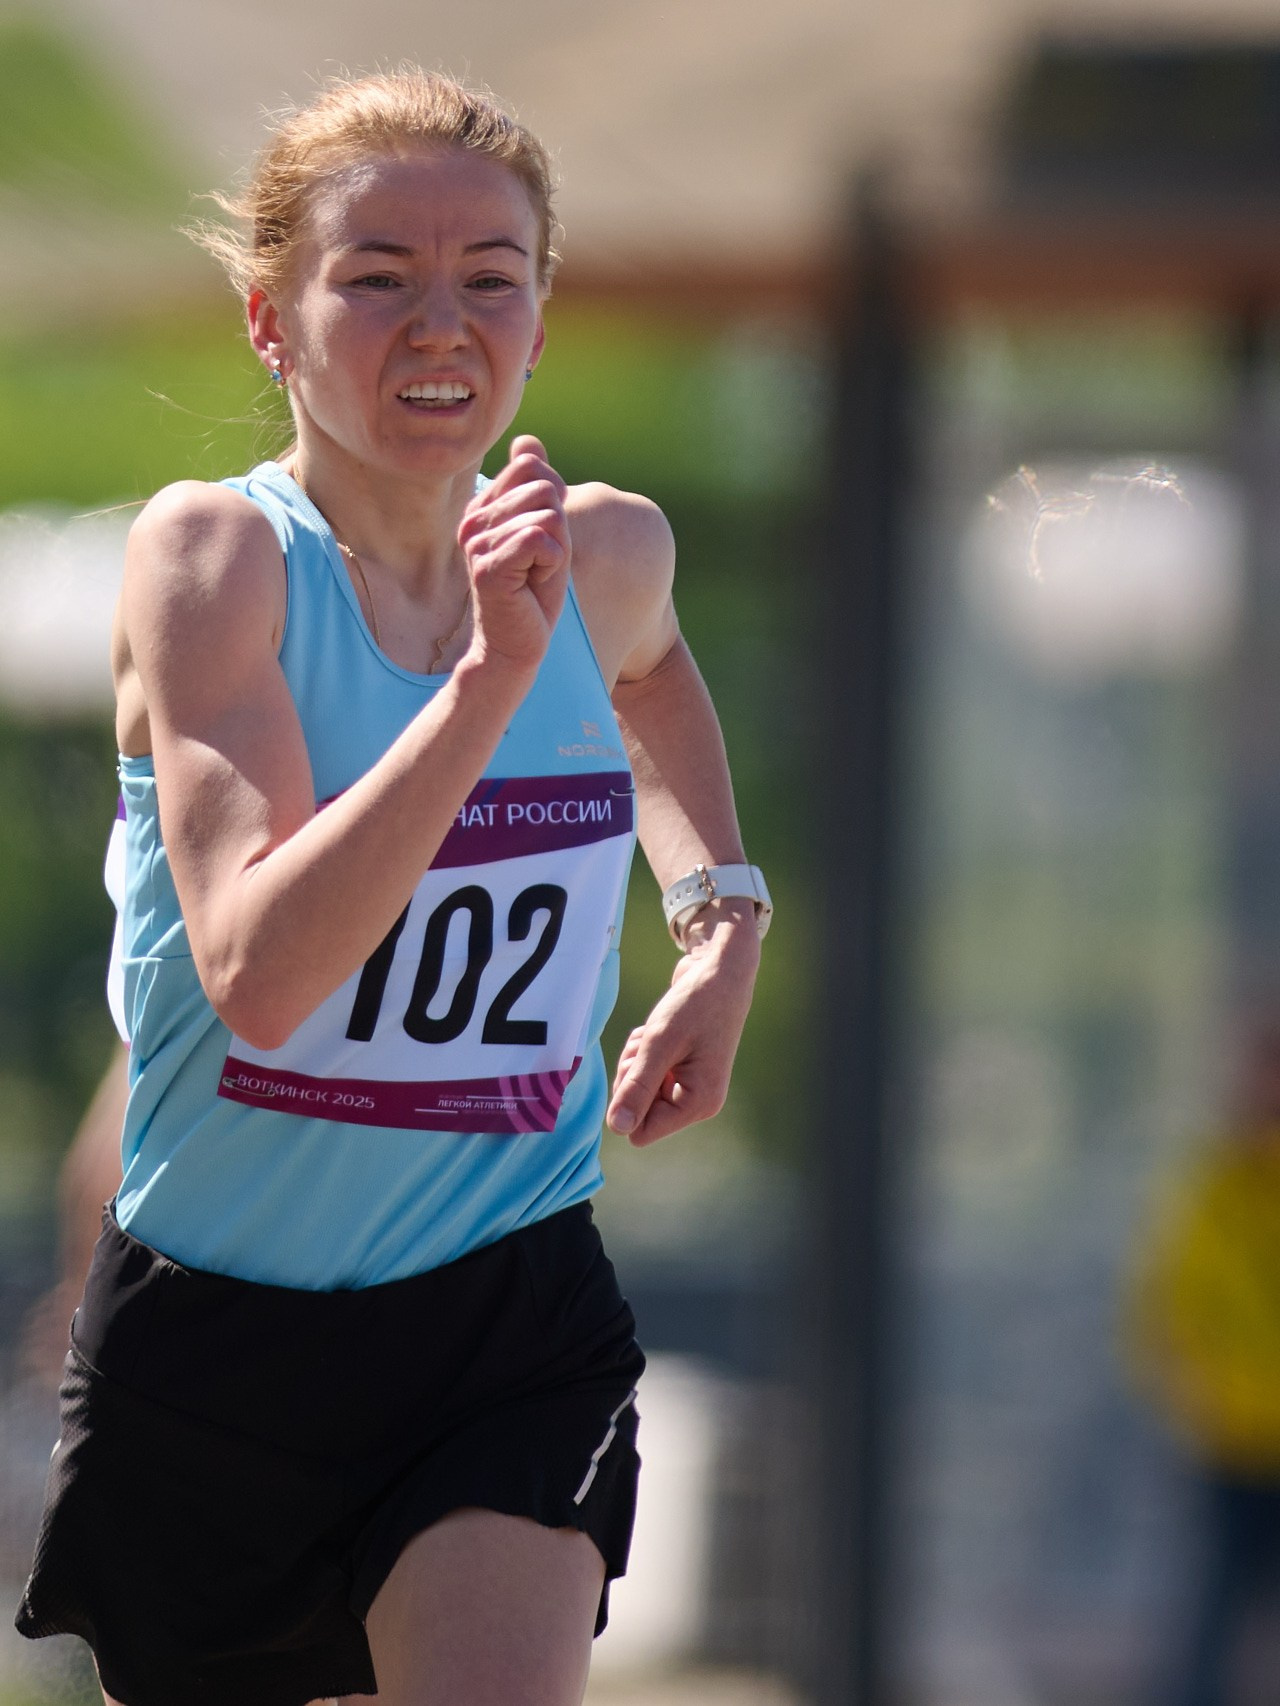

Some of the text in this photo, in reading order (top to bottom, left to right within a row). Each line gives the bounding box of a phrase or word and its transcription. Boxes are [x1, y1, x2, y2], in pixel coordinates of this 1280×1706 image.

[506, 799, 612, 826] РОССИИ
[345, 883, 568, 1045] 102
[237, 1073, 376, 1109] ВОТКИНСК 2025
